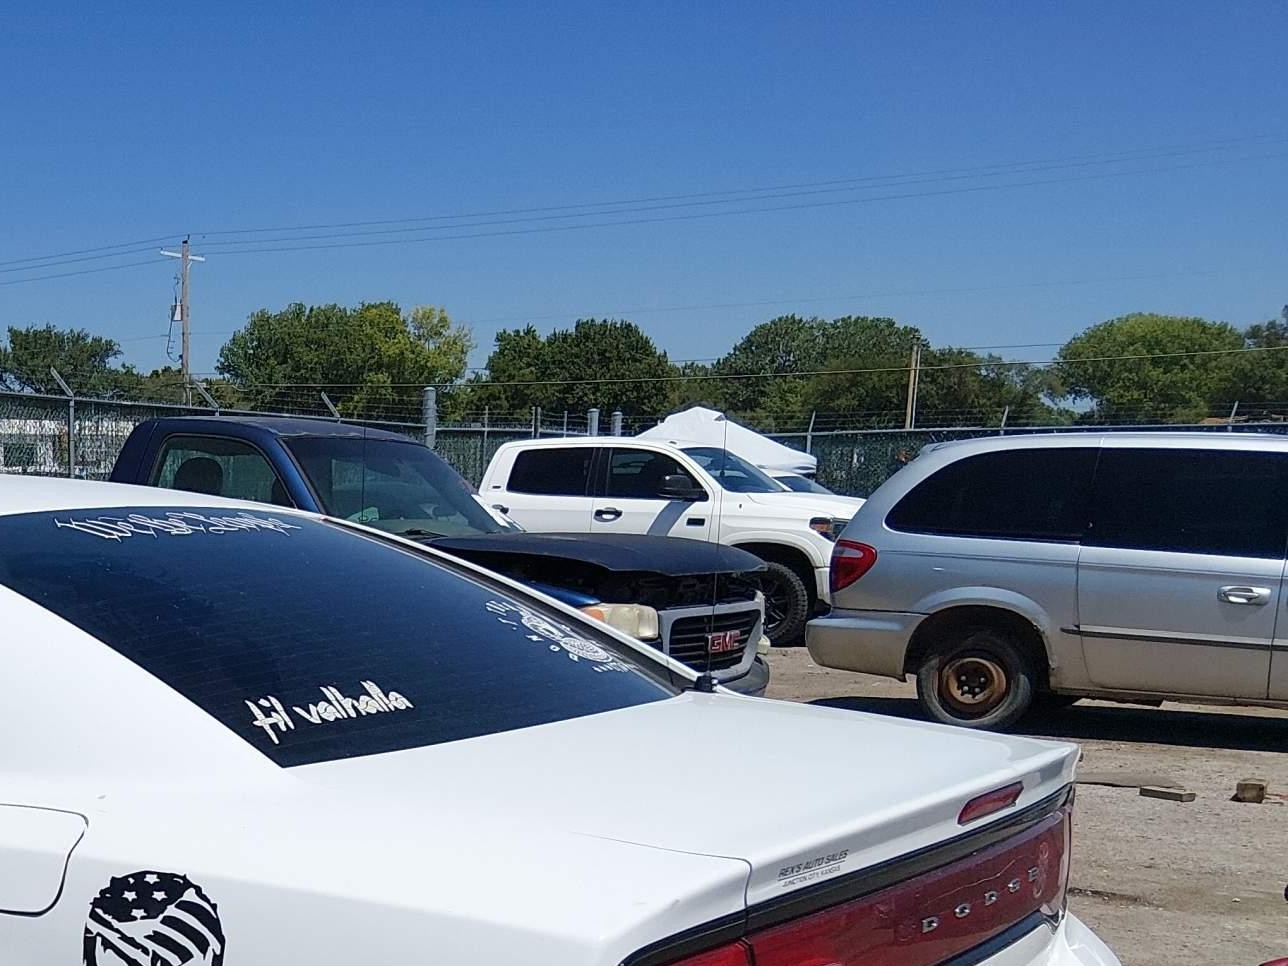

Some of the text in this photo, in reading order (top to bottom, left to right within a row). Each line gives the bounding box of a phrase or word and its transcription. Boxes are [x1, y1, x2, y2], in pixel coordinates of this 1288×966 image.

[54, 516, 158, 543] We
[707, 628, 741, 654] GMC
[244, 680, 415, 745] til valhalla
[803, 857, 825, 869] AUTO
[825, 849, 849, 863] SALES
[920, 865, 1040, 934] DODGE
